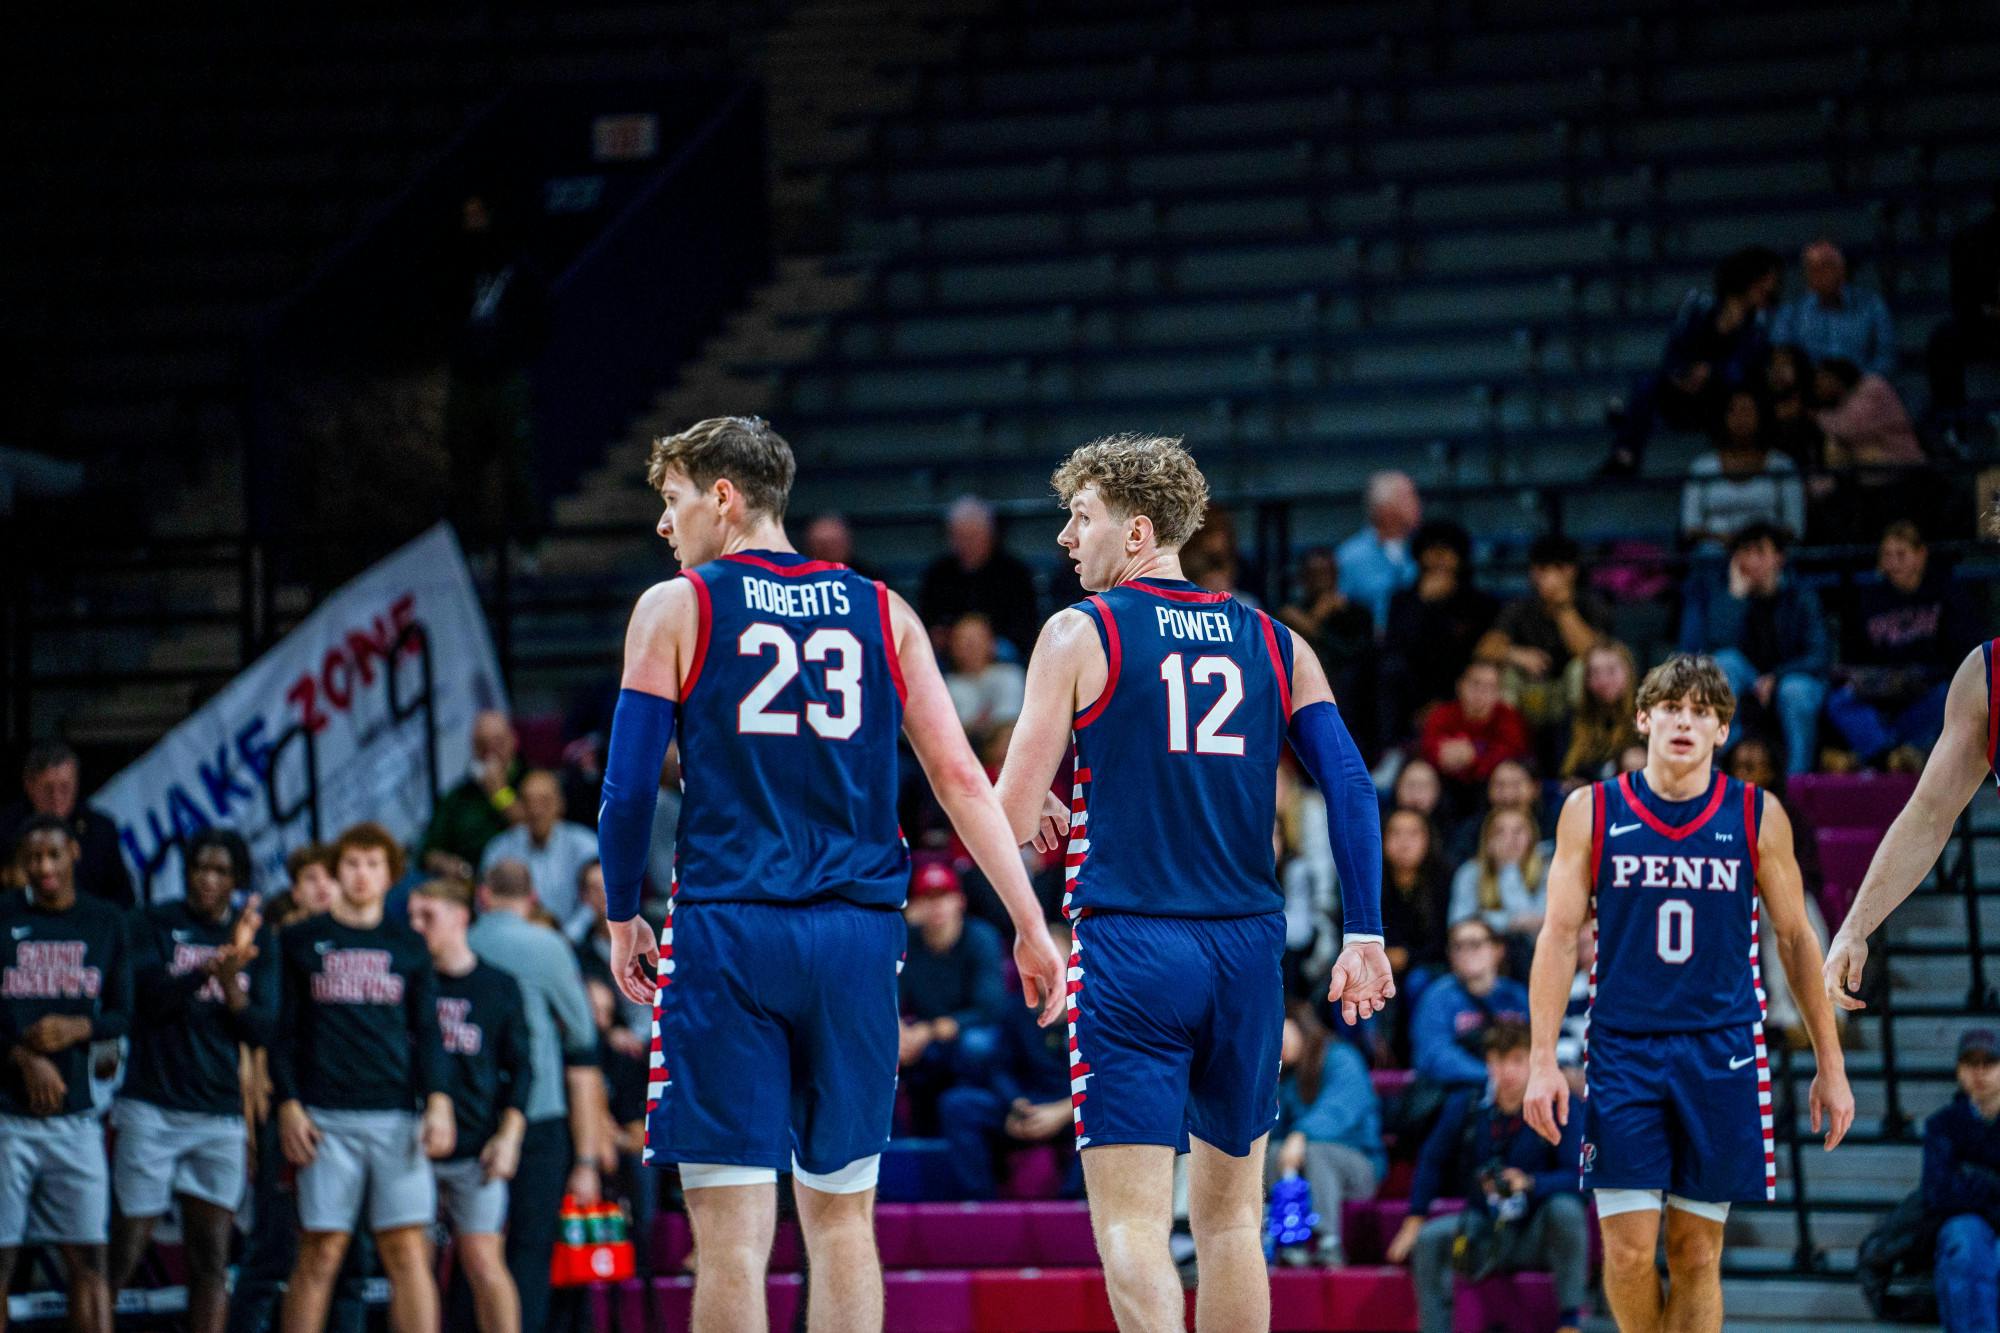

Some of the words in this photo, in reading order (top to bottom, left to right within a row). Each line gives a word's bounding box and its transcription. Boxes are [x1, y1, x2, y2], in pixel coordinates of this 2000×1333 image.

[742, 576, 850, 617] ROBERTS
[1155, 606, 1233, 642] POWER
[737, 622, 864, 740] 23
[1160, 652, 1245, 756] 12
[119, 714, 277, 878] UAKE
[286, 591, 417, 736] ZONE
[1611, 855, 1741, 891] PENN
[1657, 899, 1694, 964] 0
